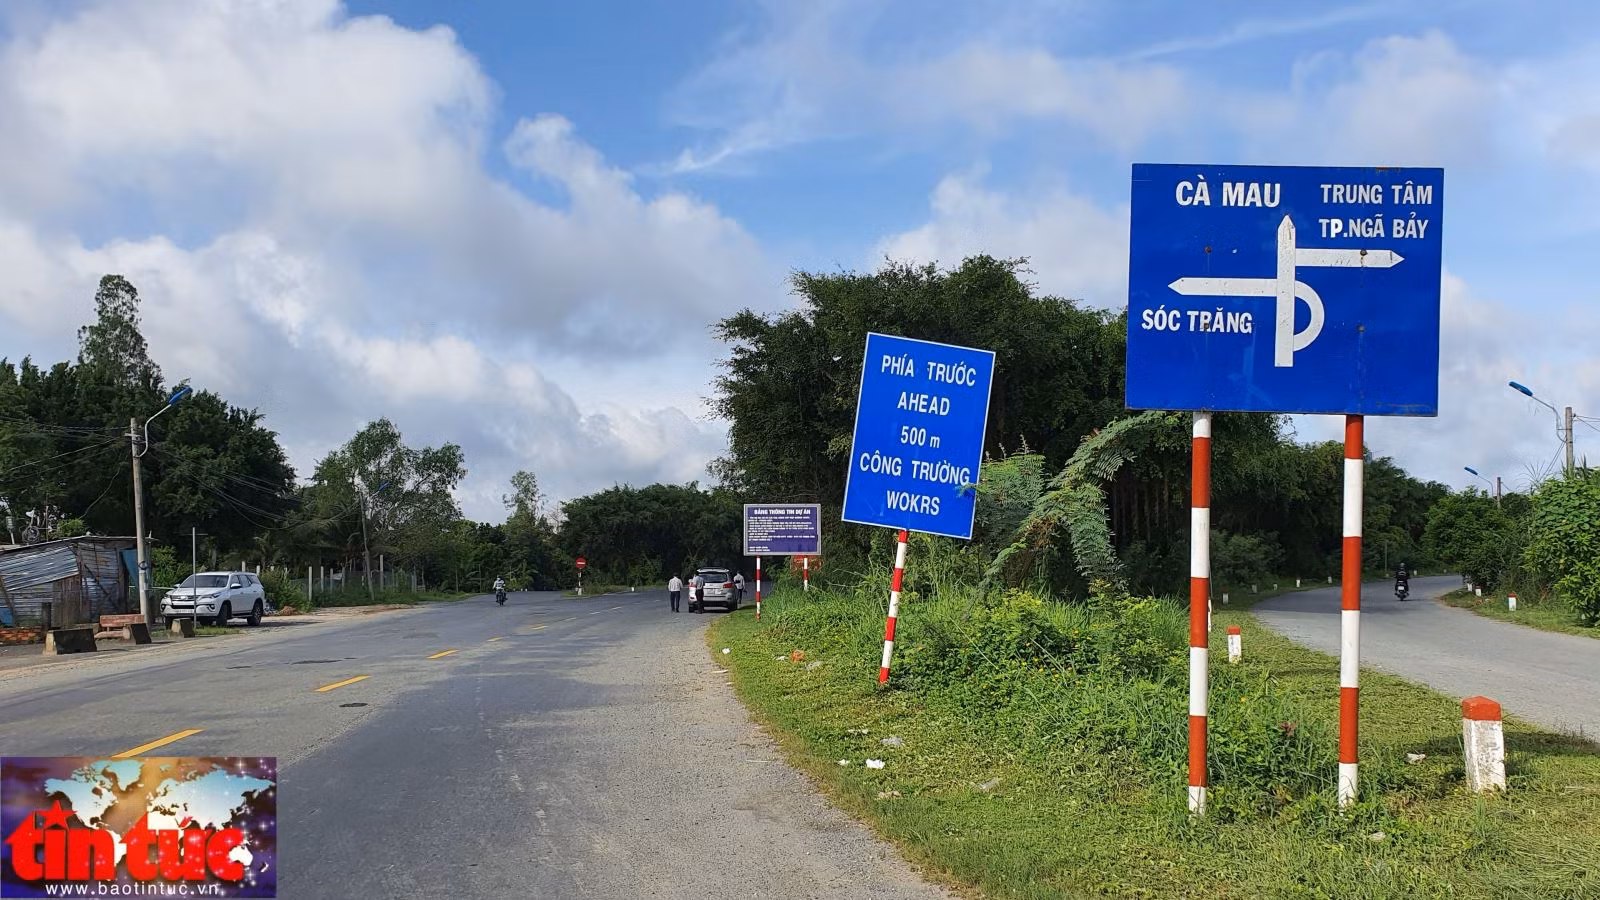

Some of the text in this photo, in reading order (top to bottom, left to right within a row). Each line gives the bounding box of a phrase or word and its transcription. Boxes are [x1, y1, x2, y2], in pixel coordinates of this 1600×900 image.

[1175, 175, 1281, 208] CÀ MAU
[1320, 180, 1433, 205] TRUNG TÂM
[1318, 212, 1429, 239] TP.NGÃ BẢY
[1141, 305, 1253, 334] SÓC TRĂNG
[881, 353, 977, 387] PHÍA TRƯỚC
[897, 391, 950, 416] AHEAD
[900, 425, 940, 449] 500 m
[859, 450, 970, 486] CÔNG TRƯỜNG
[886, 490, 940, 516] WOKRS
